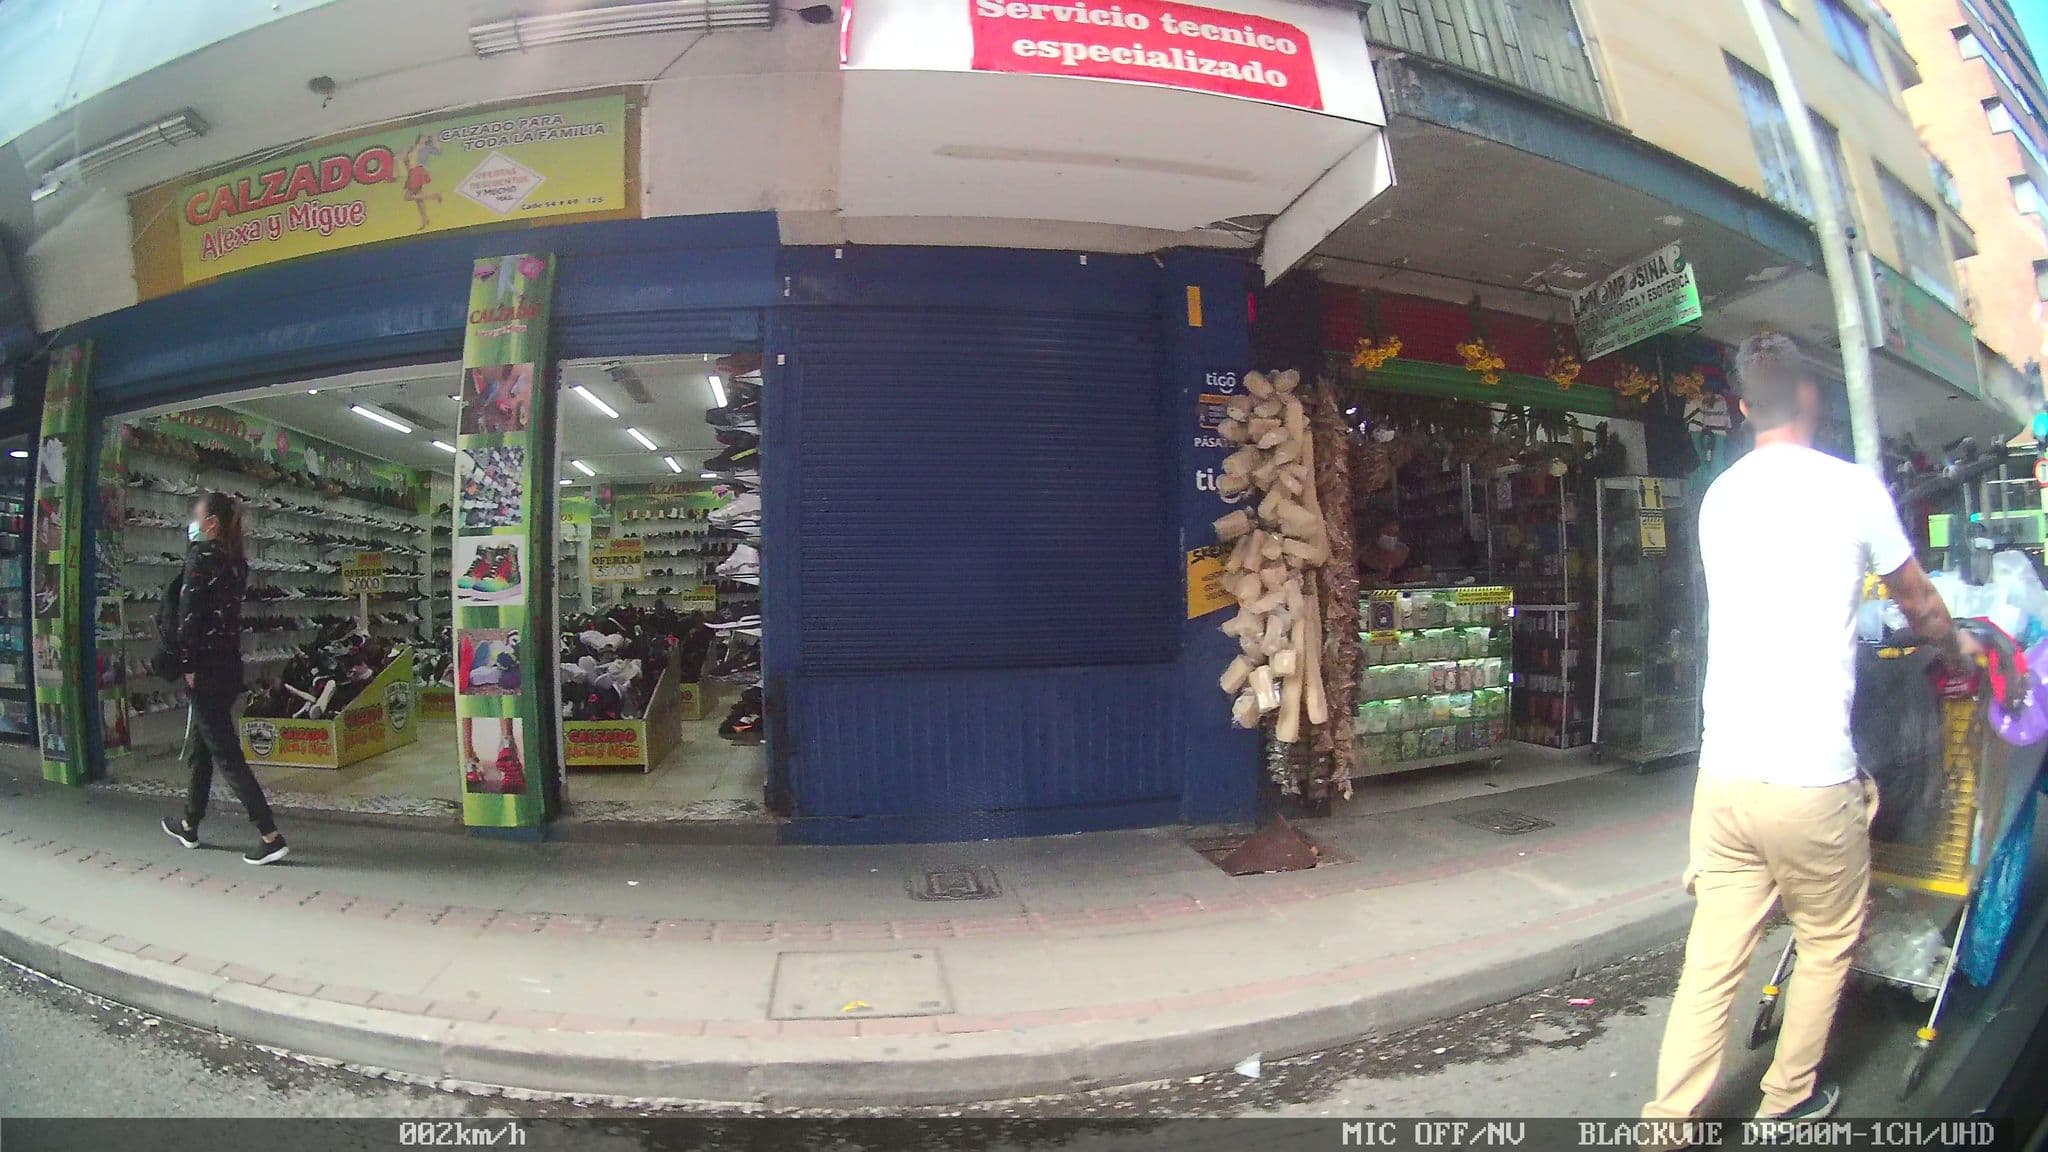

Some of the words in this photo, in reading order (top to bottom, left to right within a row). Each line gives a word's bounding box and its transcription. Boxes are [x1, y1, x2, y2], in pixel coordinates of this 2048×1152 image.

[976, 0, 1150, 30] Servicio
[1159, 13, 1298, 56] tecnico
[1012, 38, 1288, 88] especializado
[441, 121, 515, 141] CALZADO
[518, 113, 564, 130] PARA
[463, 136, 511, 151] TODA
[513, 131, 534, 145] LA
[537, 123, 606, 141] FAMILIA
[186, 145, 396, 225] CALZADO
[201, 219, 263, 261] Alexa
[266, 214, 284, 241] y
[288, 201, 366, 237] Migue
[592, 555, 641, 566] OFERTAS
